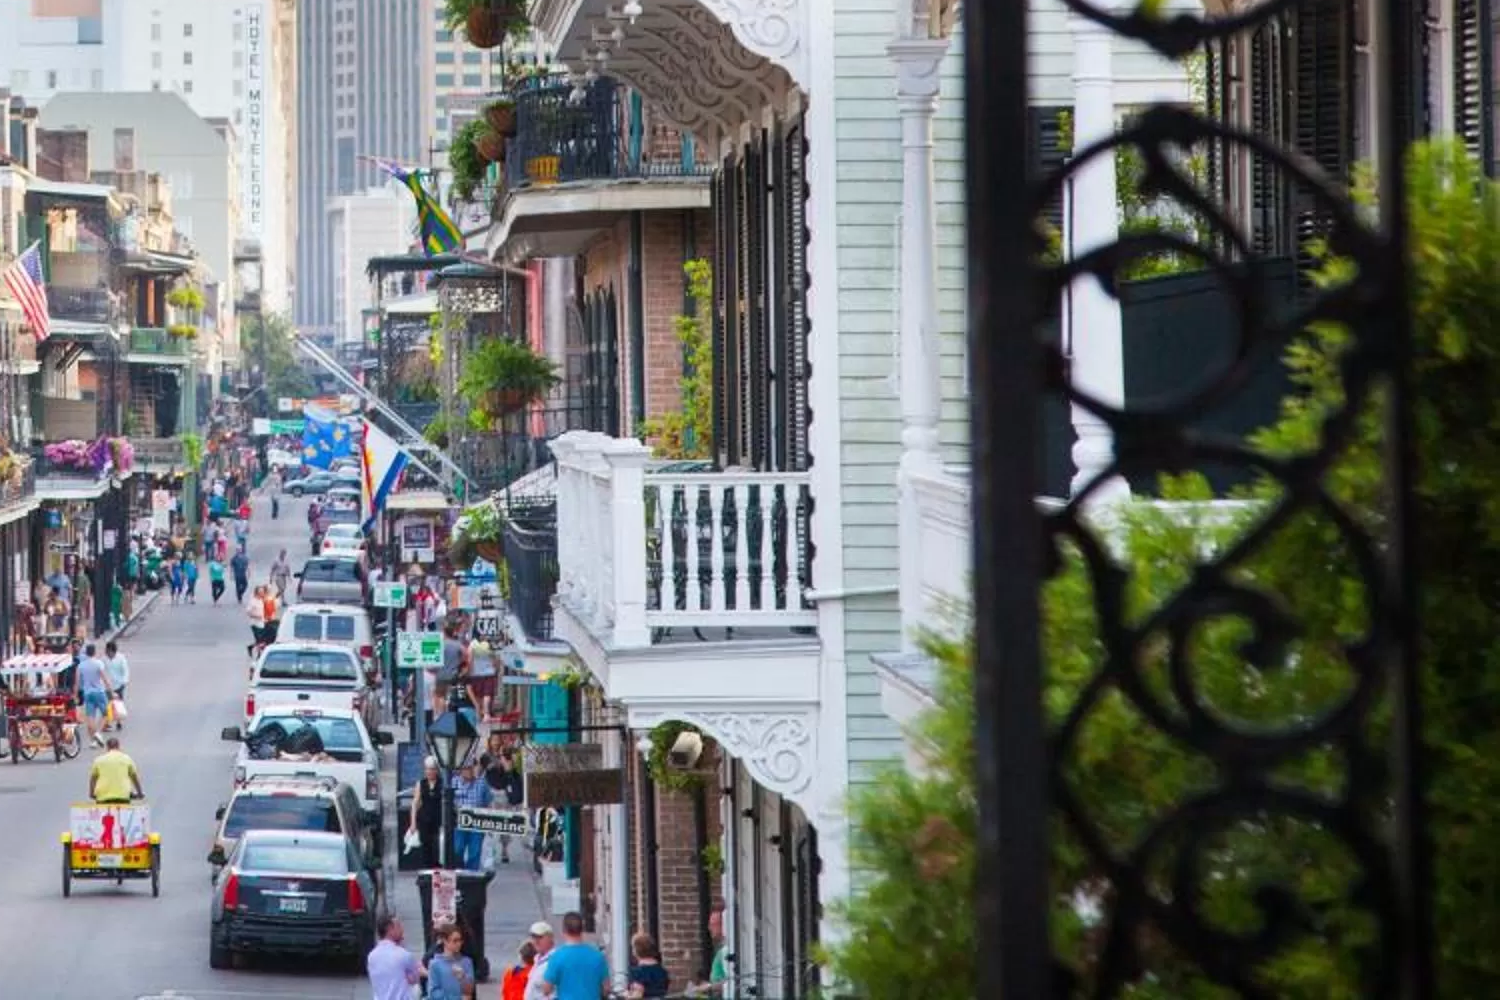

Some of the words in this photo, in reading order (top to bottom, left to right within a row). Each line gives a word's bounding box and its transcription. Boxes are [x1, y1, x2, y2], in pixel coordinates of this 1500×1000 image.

[249, 12, 260, 80] HOTEL
[249, 90, 261, 223] MONTELEONE
[460, 813, 523, 833] Dumaine
